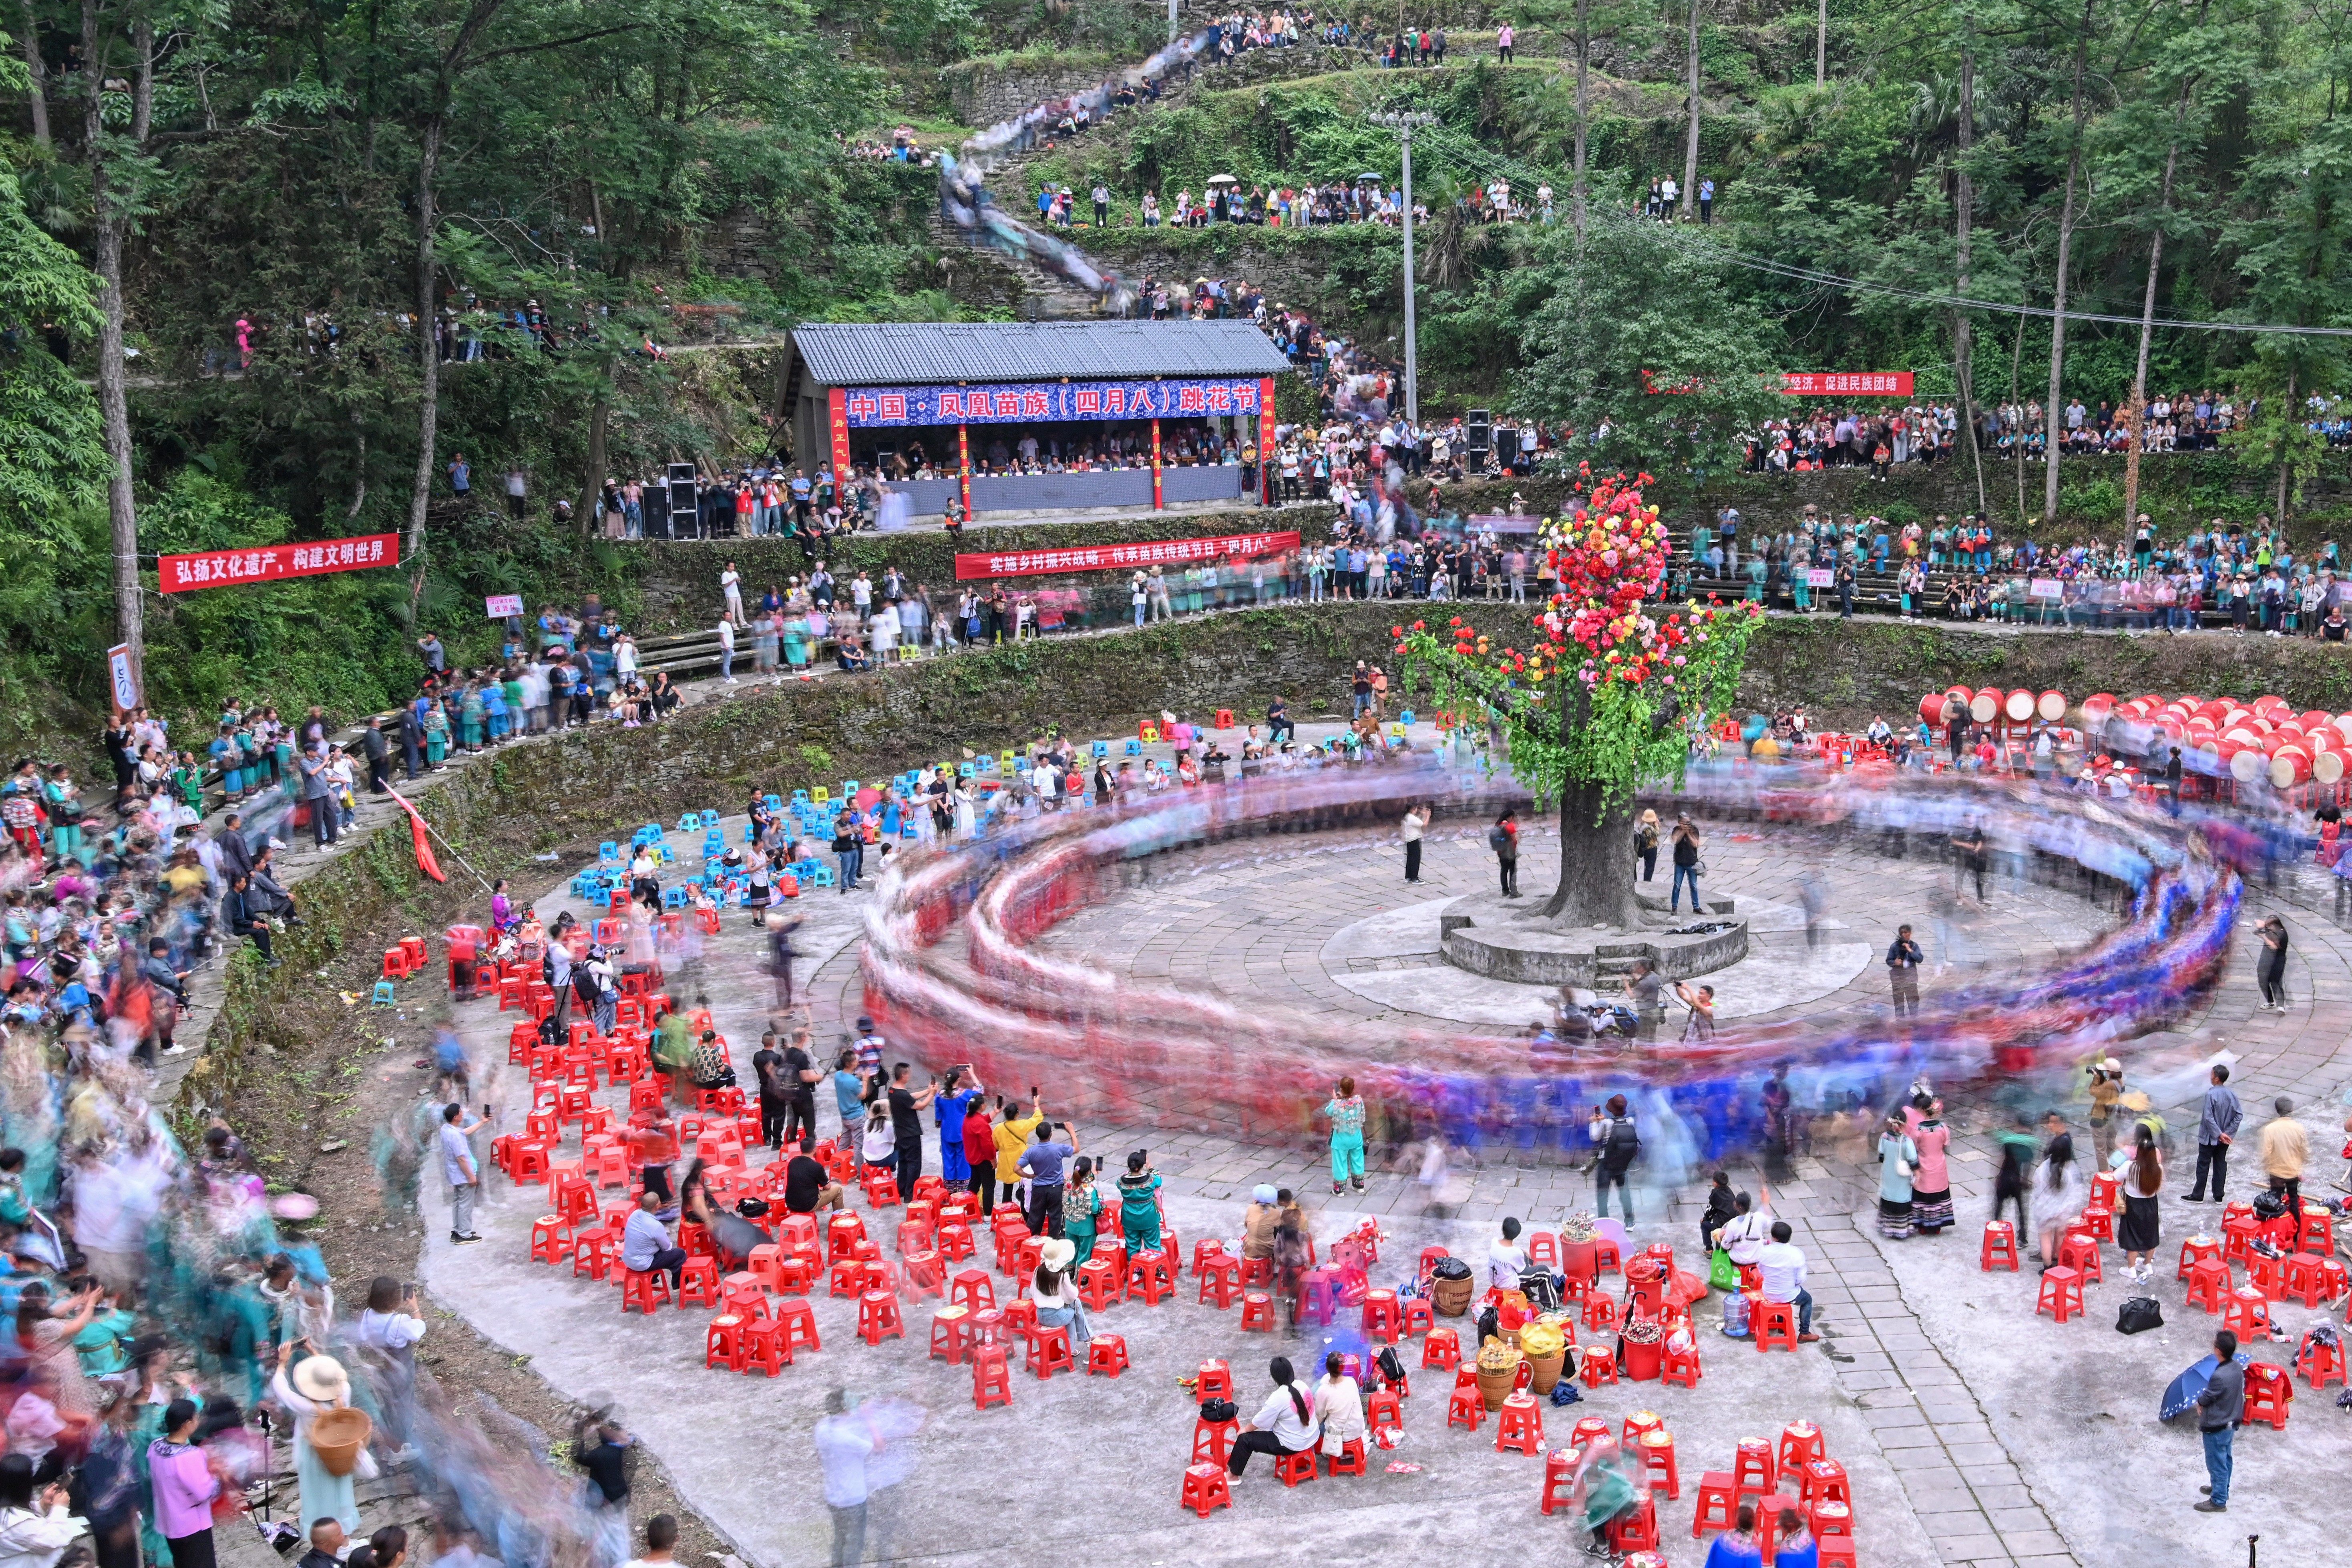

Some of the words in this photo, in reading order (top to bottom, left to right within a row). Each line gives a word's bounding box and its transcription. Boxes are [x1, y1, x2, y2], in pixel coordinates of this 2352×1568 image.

[959, 431, 970, 494] 国泰民安
[1152, 426, 1162, 487] 风调雨顺
[176, 541, 383, 584] 弘扬文化遗产，构建文明世界
[495, 604, 517, 612] 盛装队
